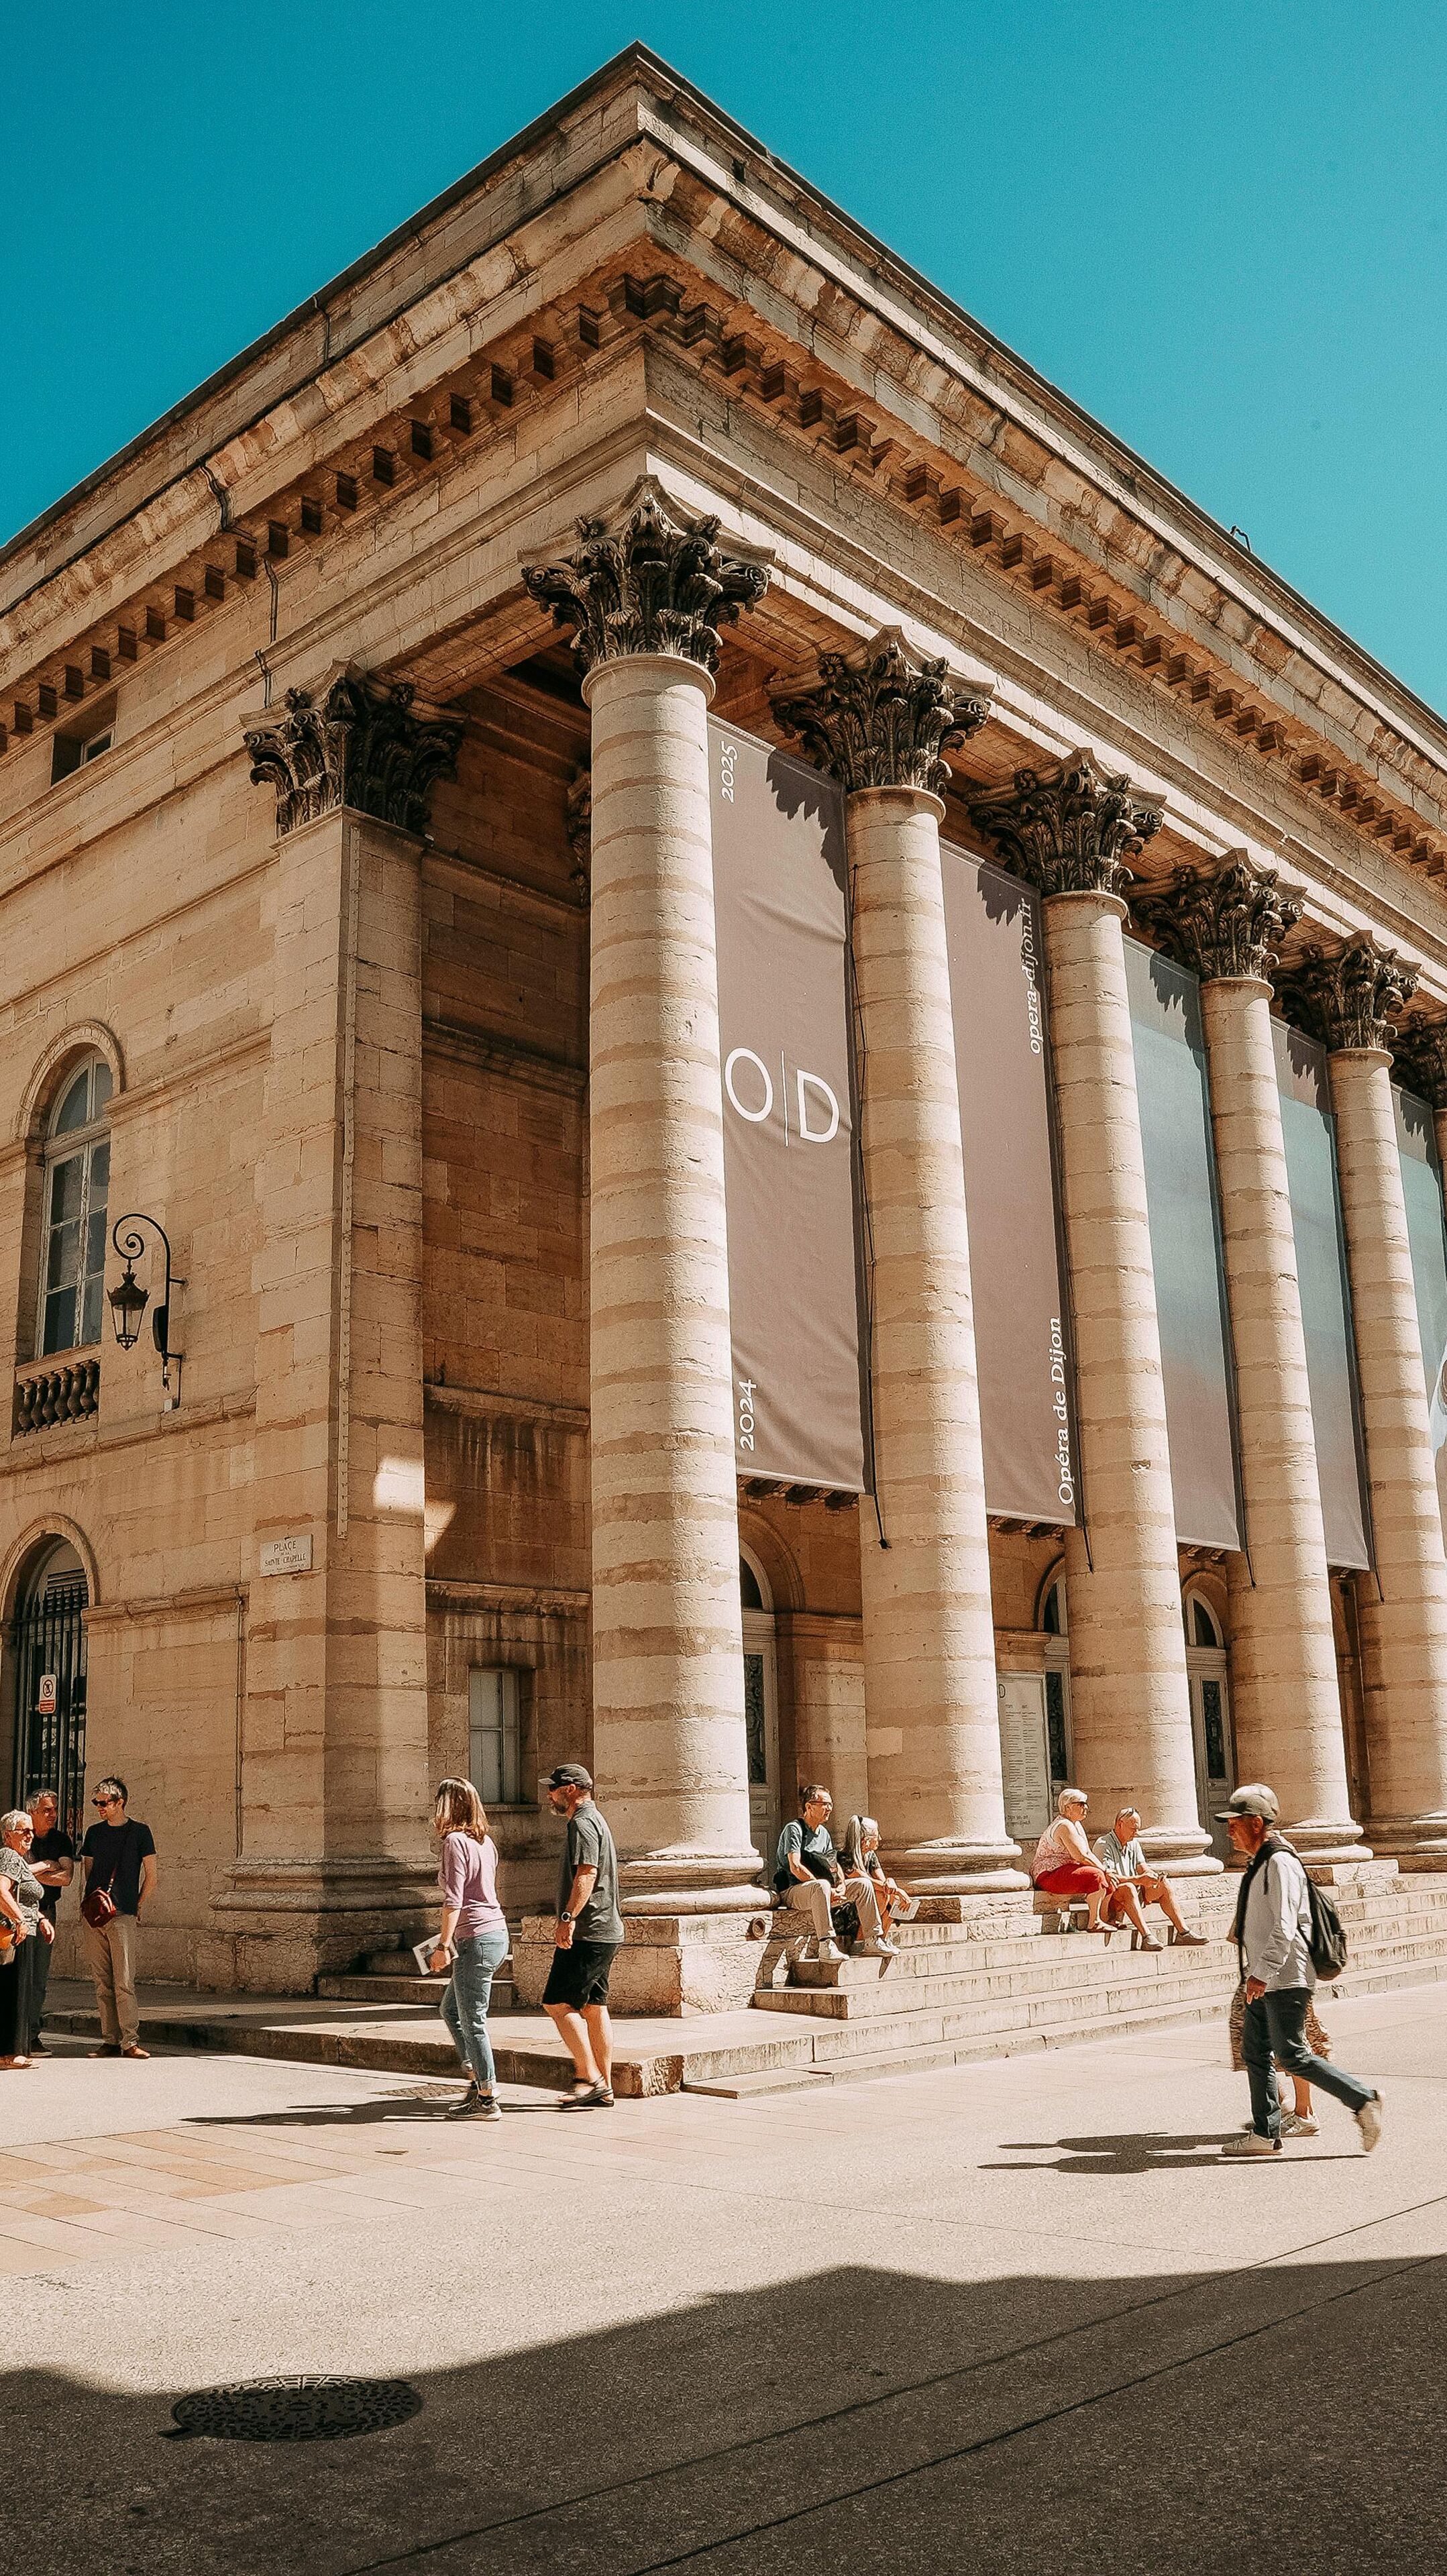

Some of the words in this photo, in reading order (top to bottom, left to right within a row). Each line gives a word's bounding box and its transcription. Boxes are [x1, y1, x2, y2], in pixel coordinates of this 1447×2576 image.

[720, 740, 738, 804] 2025
[1018, 898, 1044, 1055] opera-dijon.fr
[1049, 1317, 1067, 1385] Dijon
[738, 1379, 757, 1452] 2024
[1053, 1391, 1067, 1421] de
[1055, 1427, 1075, 1505] Opéra
[274, 1541, 297, 1552] PLACE
